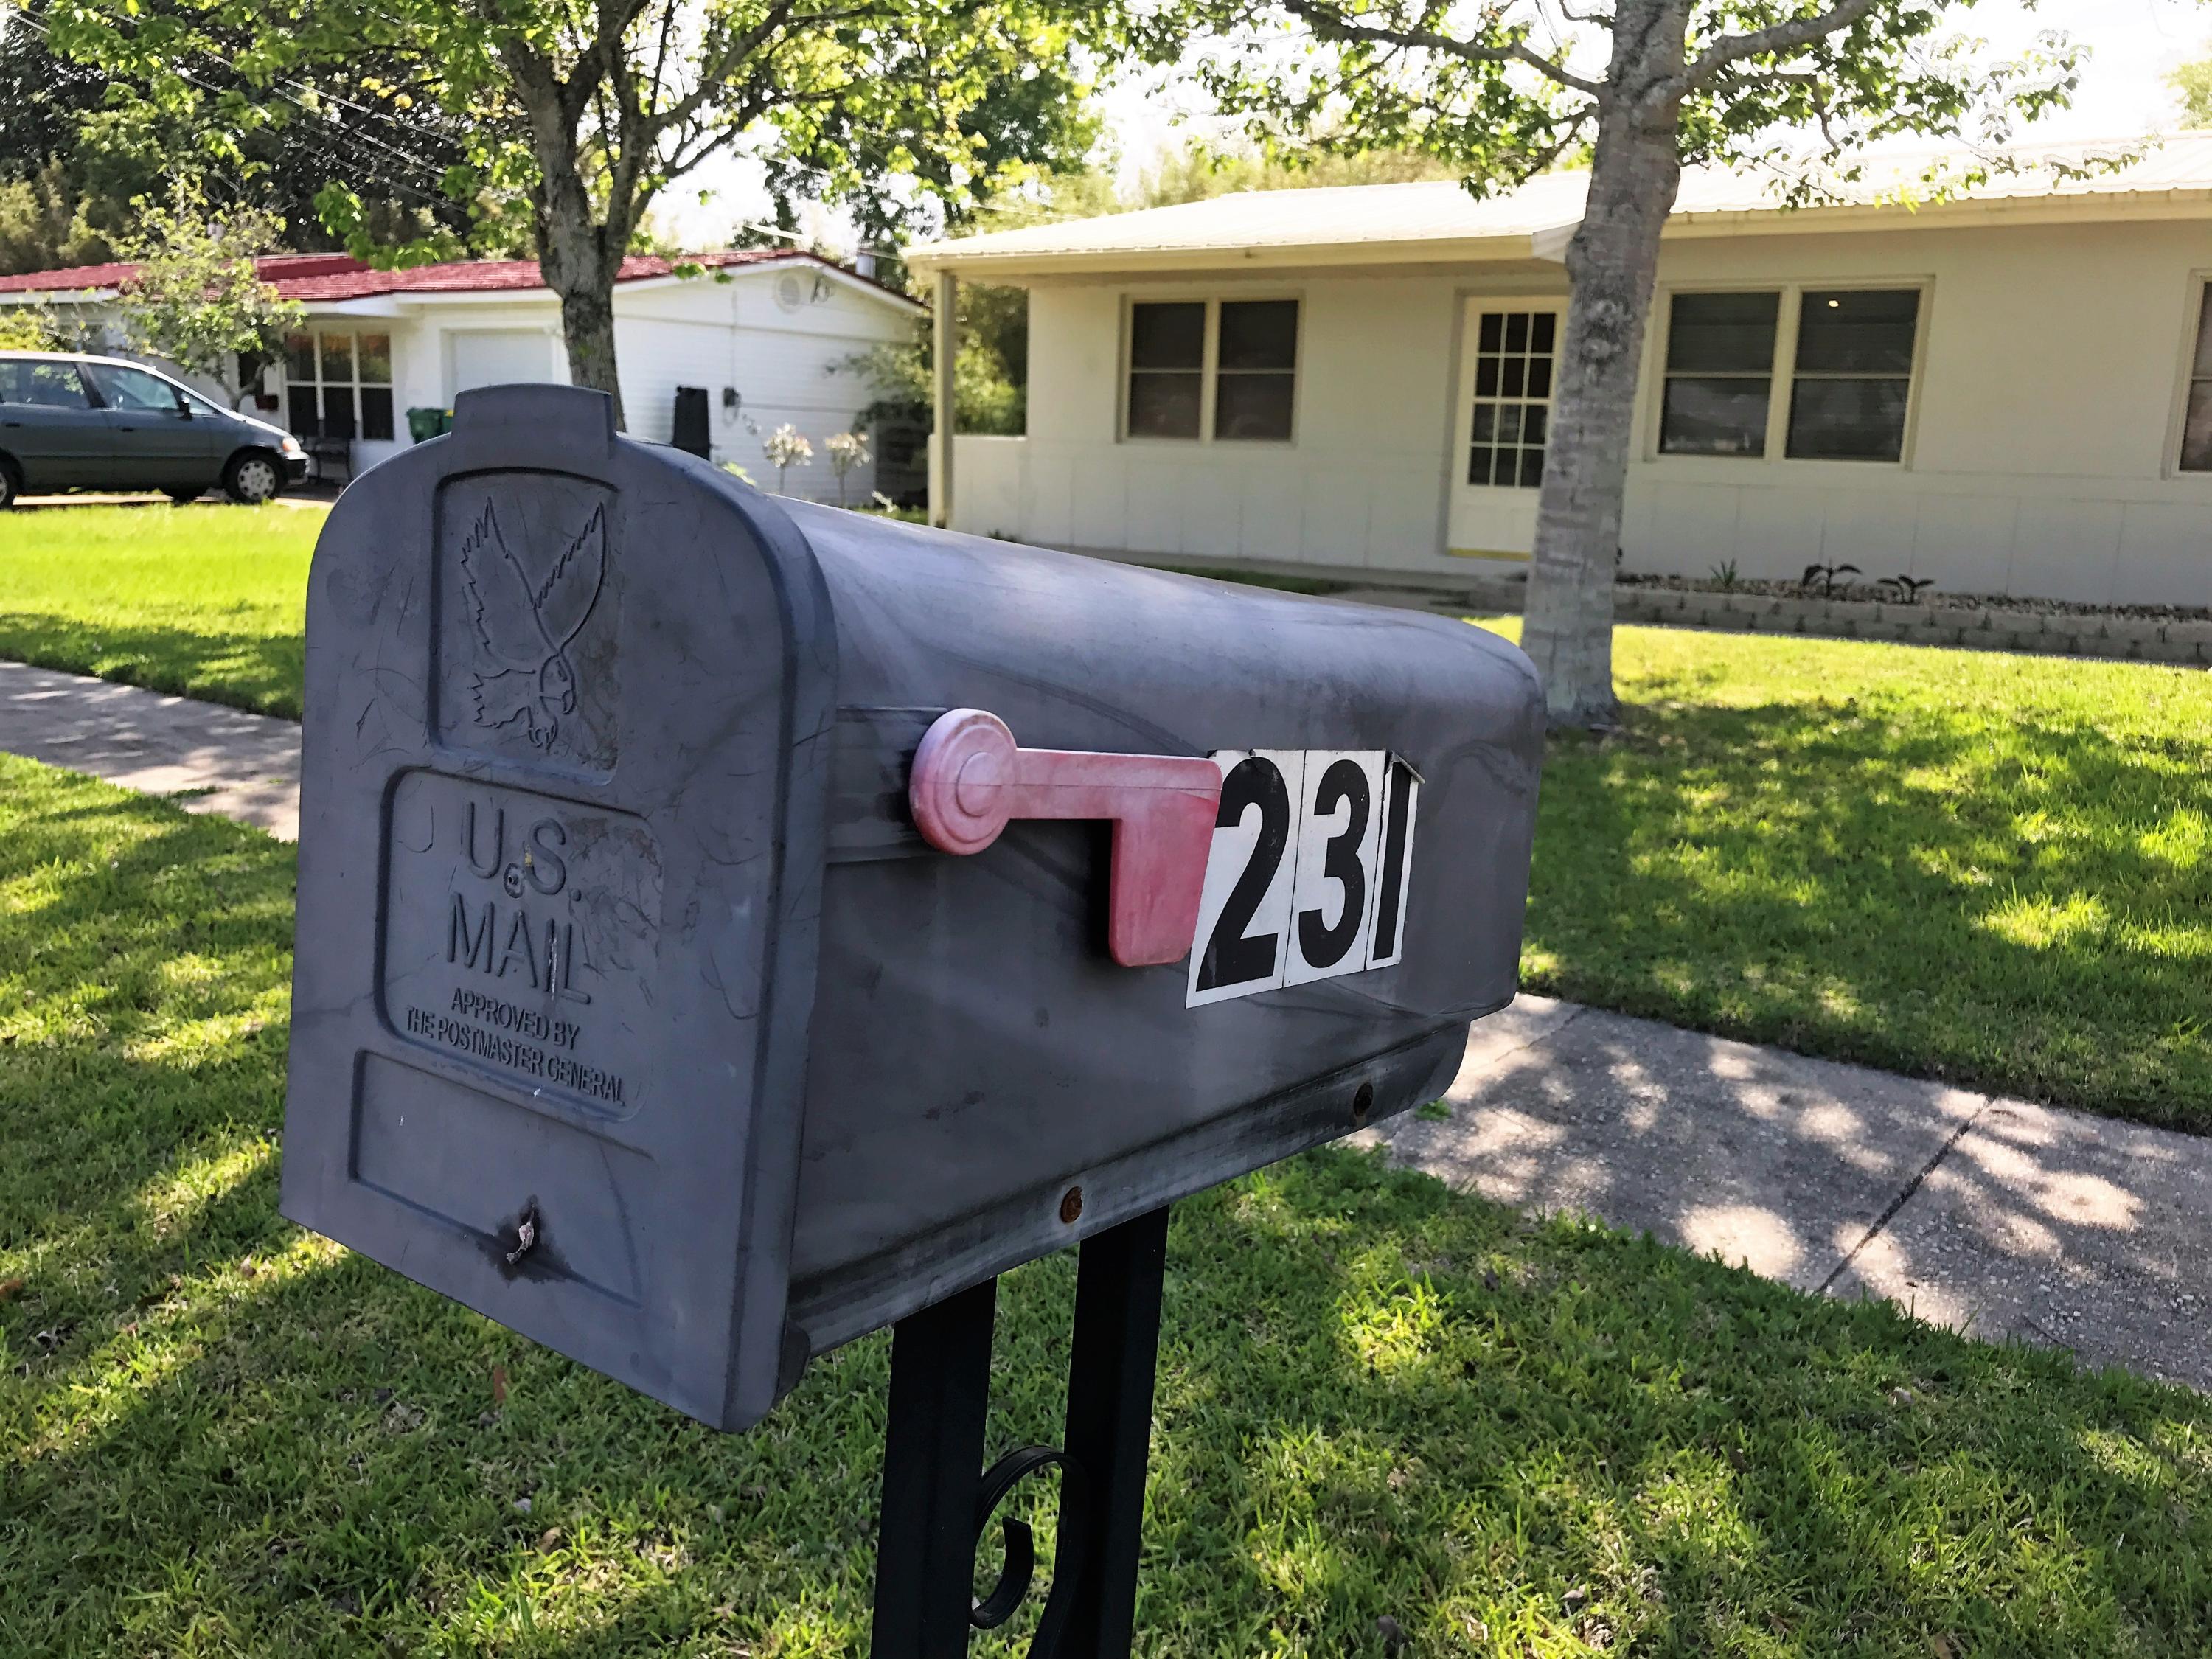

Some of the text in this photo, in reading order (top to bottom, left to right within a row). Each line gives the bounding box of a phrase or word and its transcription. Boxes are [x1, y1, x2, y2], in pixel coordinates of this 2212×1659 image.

[1196, 756, 1412, 992] 231
[447, 891, 591, 1004] MAIL
[406, 1006, 626, 1107] THE POSTMASTER GENERAL
[451, 987, 580, 1051] APPROVED BY
